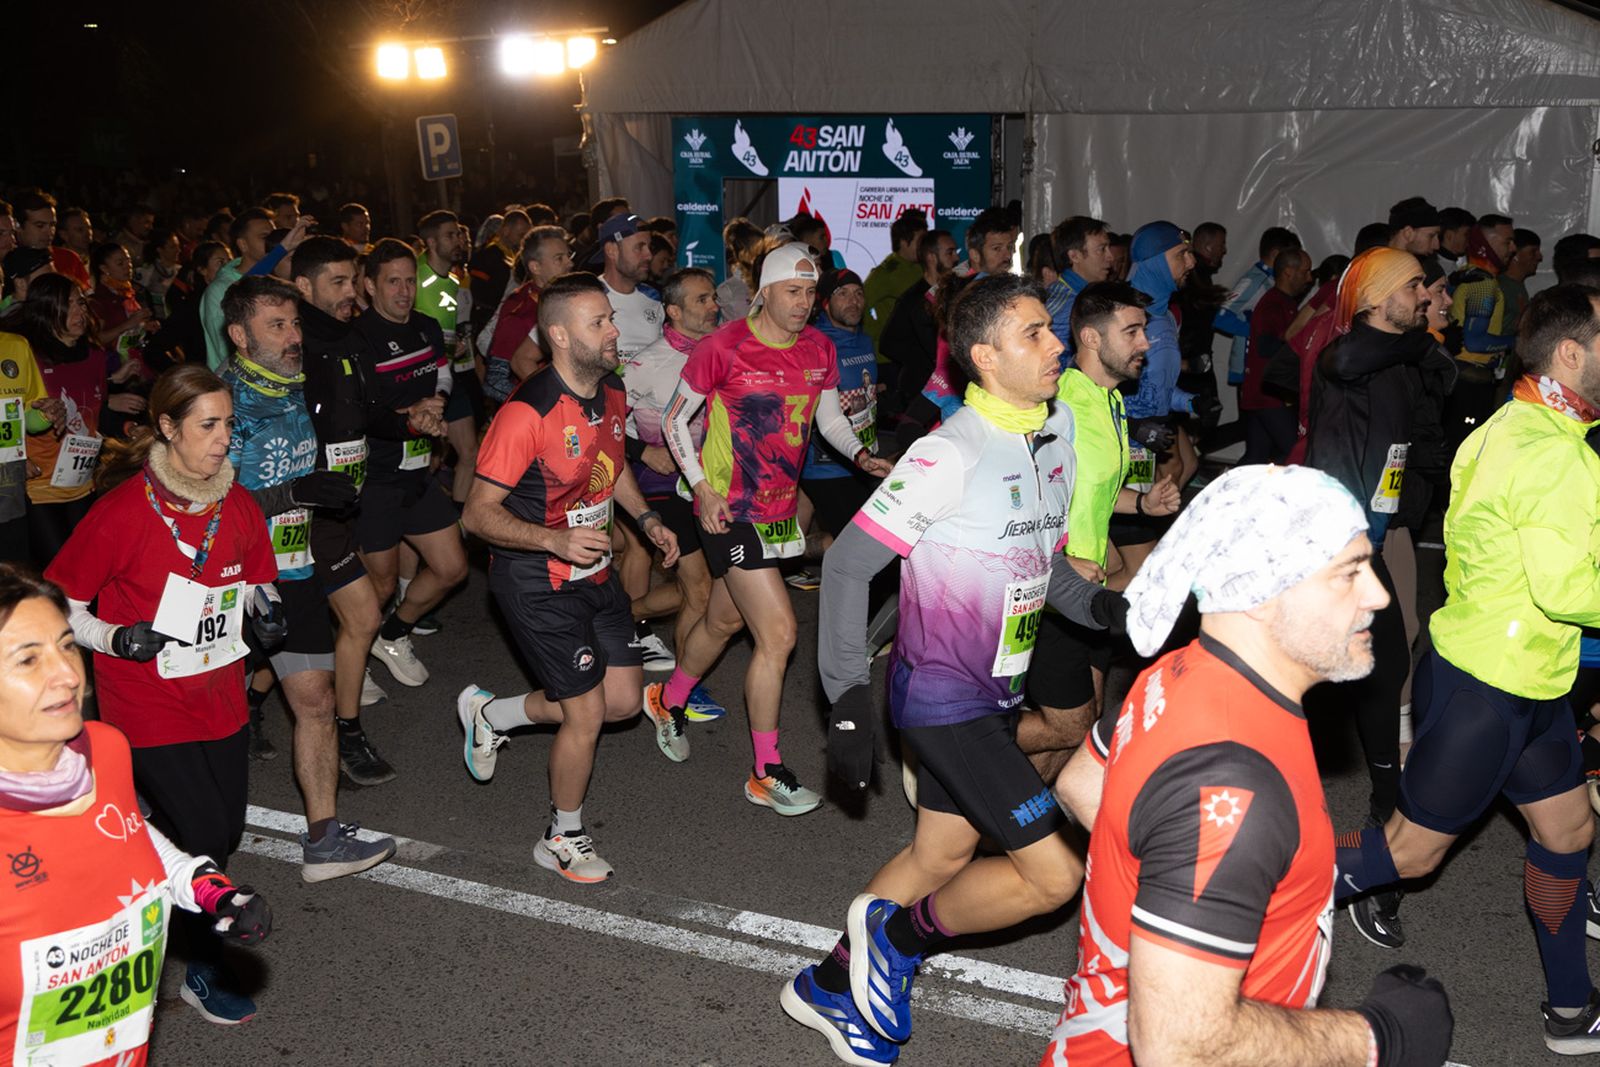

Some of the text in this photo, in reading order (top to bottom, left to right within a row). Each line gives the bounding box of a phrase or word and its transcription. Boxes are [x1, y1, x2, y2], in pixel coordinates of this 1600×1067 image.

[427, 123, 451, 172] P
[789, 124, 866, 149] 43 SAN
[742, 150, 757, 167] 43
[783, 144, 862, 172] ANTÓN
[894, 151, 910, 168] 43
[677, 203, 718, 212] calderón
[856, 204, 893, 219] SAN
[785, 394, 809, 447] 3
[258, 458, 291, 480] 38
[70, 936, 113, 965] NOCHE
[115, 924, 130, 943] DE
[48, 966, 83, 989] SAN
[85, 942, 130, 978] ANTÓN
[55, 949, 154, 1026] 2280
[87, 1005, 130, 1030] Natividad
